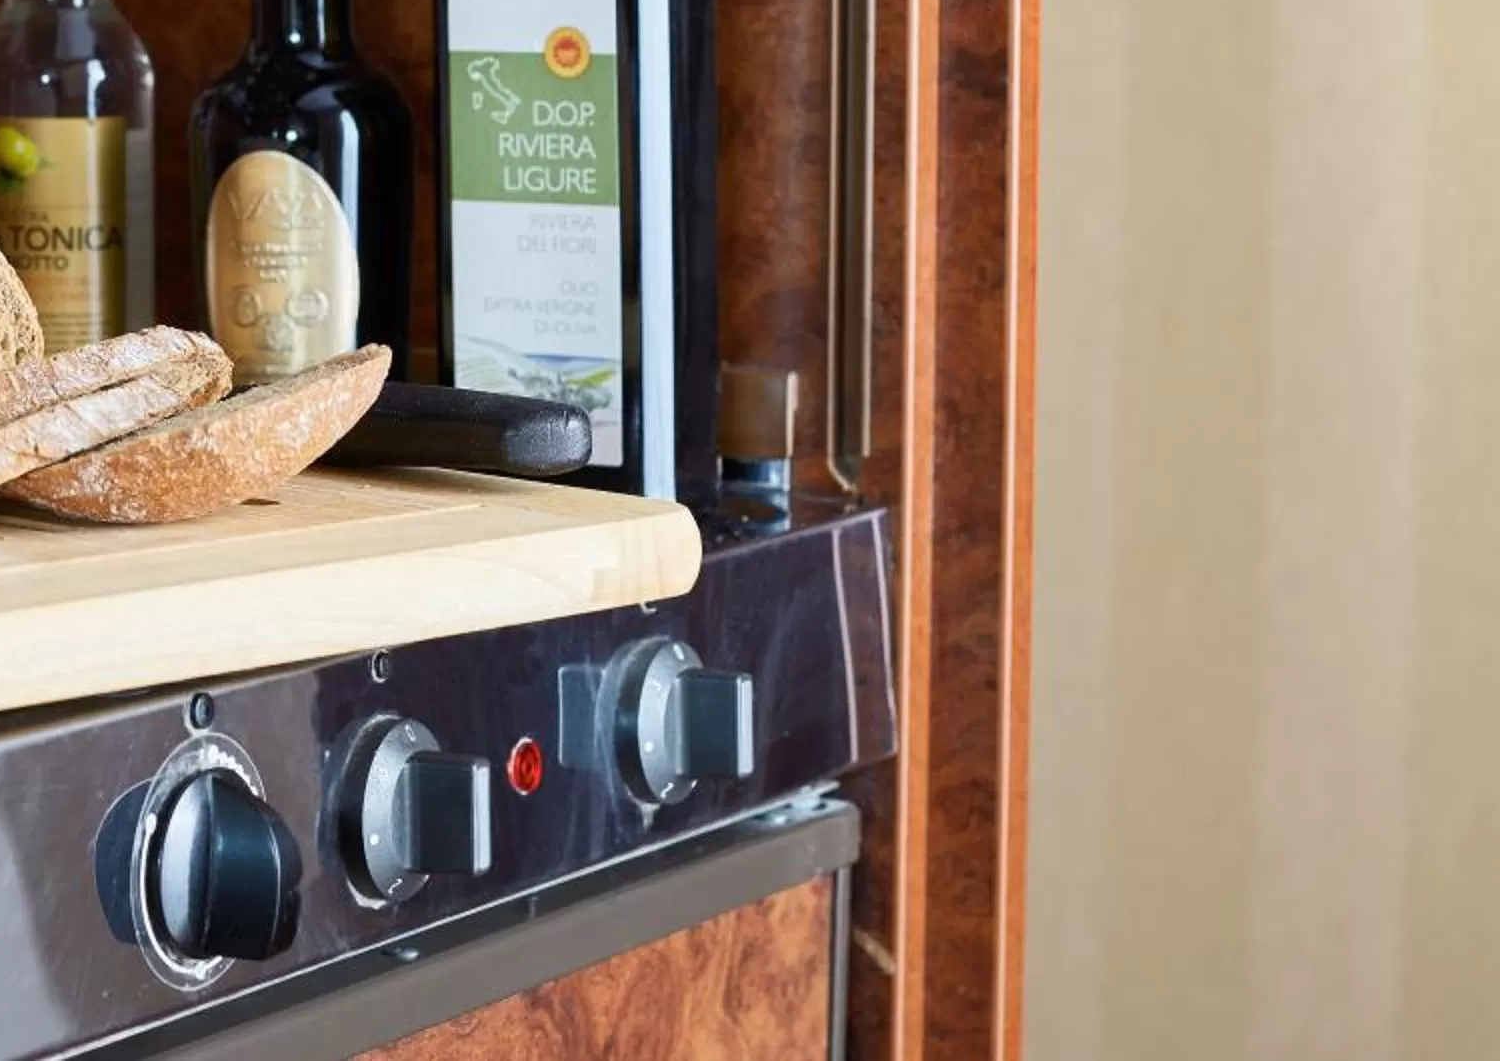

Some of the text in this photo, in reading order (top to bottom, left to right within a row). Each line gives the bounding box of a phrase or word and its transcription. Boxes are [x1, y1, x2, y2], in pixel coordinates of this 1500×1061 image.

[499, 133, 597, 159] RIVIERA
[503, 165, 597, 194] LIGURE
[7, 224, 125, 252] TONICA
